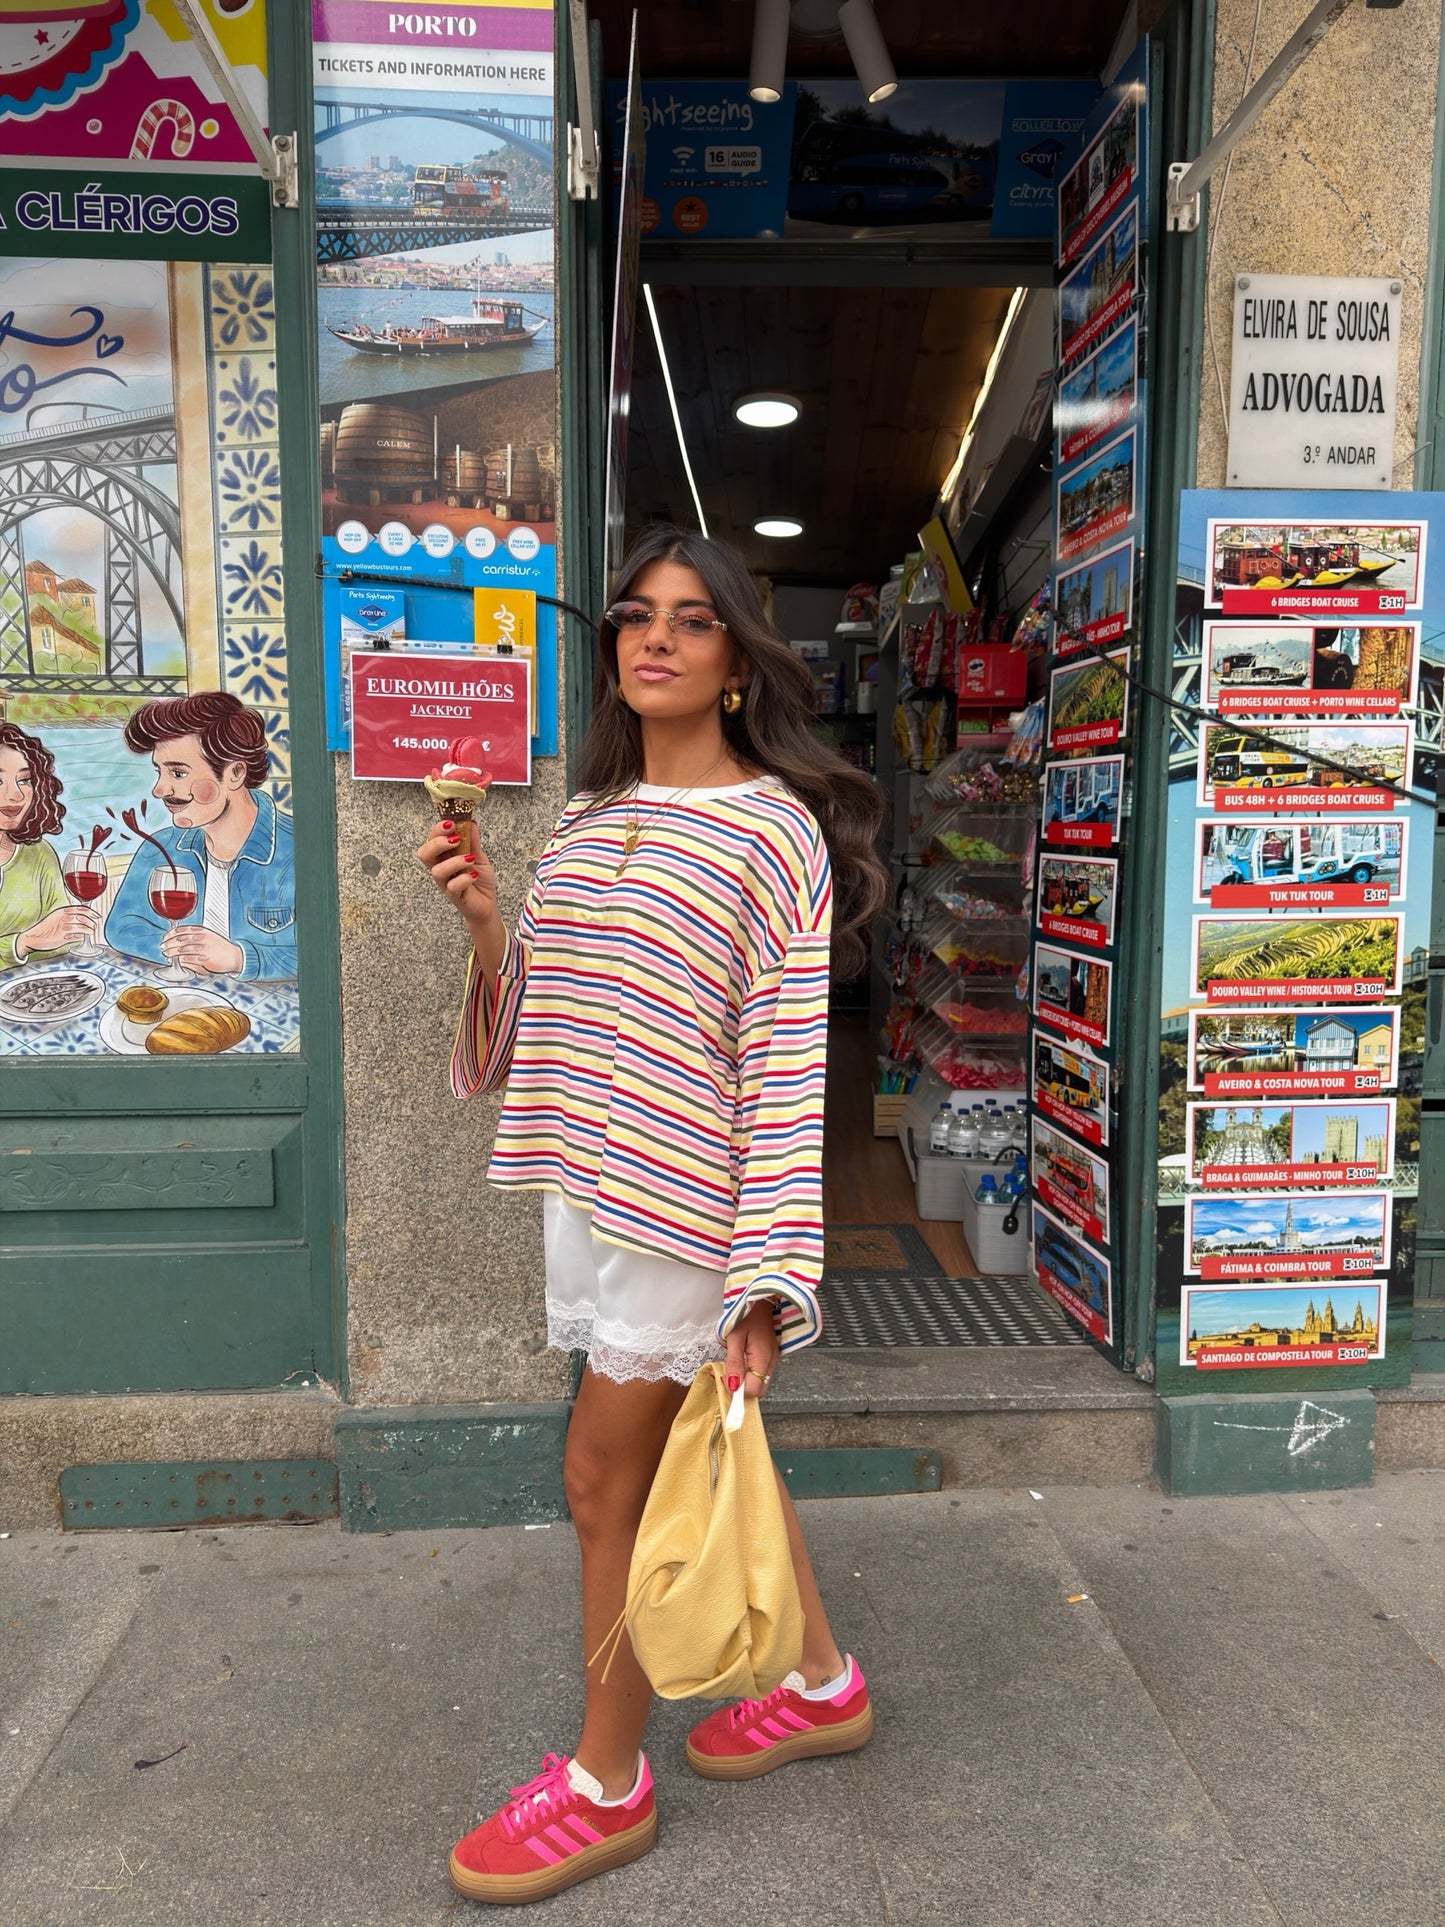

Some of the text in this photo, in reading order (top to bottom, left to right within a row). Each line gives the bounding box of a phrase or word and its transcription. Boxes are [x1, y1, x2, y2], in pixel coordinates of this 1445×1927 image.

[388, 13, 477, 37] PORTO
[318, 58, 546, 80] TICKETS AND INFORMATION HERE
[616, 95, 753, 131] Sghtseeing
[710, 152, 724, 163] 16
[15, 183, 239, 236] CLÉRIGOS
[1243, 298, 1390, 341] ELVIRA DE SOUSA
[1242, 372, 1385, 413] ADVOGADA
[1303, 446, 1376, 465] 3.º ANDAR
[1082, 526, 1097, 544] COSTA
[1098, 518, 1112, 535] NOVA
[1113, 510, 1126, 527] TOUR
[335, 563, 413, 571] www.yellowbustours.com
[482, 564, 531, 576] carristur
[1271, 597, 1402, 608] 6 BRIDGES BOAT CRUISE 1H
[366, 677, 514, 699] EUROMILHÕES
[1222, 697, 1396, 707] 6 BRIDGES BOAT CRUISE + PORTO WINE CELLARS
[410, 704, 472, 717] JACKPOT
[1072, 730, 1087, 743] VALLEY
[1088, 728, 1100, 740] WINE
[1100, 725, 1113, 738] TOUR
[481, 740, 491, 751] €
[1224, 794, 1385, 805] BUS 48H + 6 BRIDGES BOAT CRUISE
[1063, 828, 1092, 839] TUK TUK TOUR
[1269, 890, 1387, 901] TUK TUK TOUR 1H
[1052, 919, 1069, 933] BRIDGES
[1069, 923, 1081, 936] BOAT
[1081, 926, 1098, 940] CRUISE
[1212, 984, 1383, 997] DOURO VALLEY WINE / HISTORICAL TOUR 10H
[1218, 1077, 1378, 1089] AVEIRO & COSTA NOVA TOUR 4H
[1206, 1172, 1233, 1182] BRAGA
[1234, 1172, 1241, 1181] &
[1242, 1169, 1288, 1182] GUIMARÃES
[1293, 1171, 1322, 1181] MINHO
[1322, 1170, 1343, 1180] TOUR
[1356, 1168, 1375, 1177] 10H
[1221, 1260, 1372, 1274] FÁTIMA & COIMBRA TOUR 10H
[1201, 1349, 1366, 1364] SANTIAGO DE COMPOSTELA TOUR 10H
